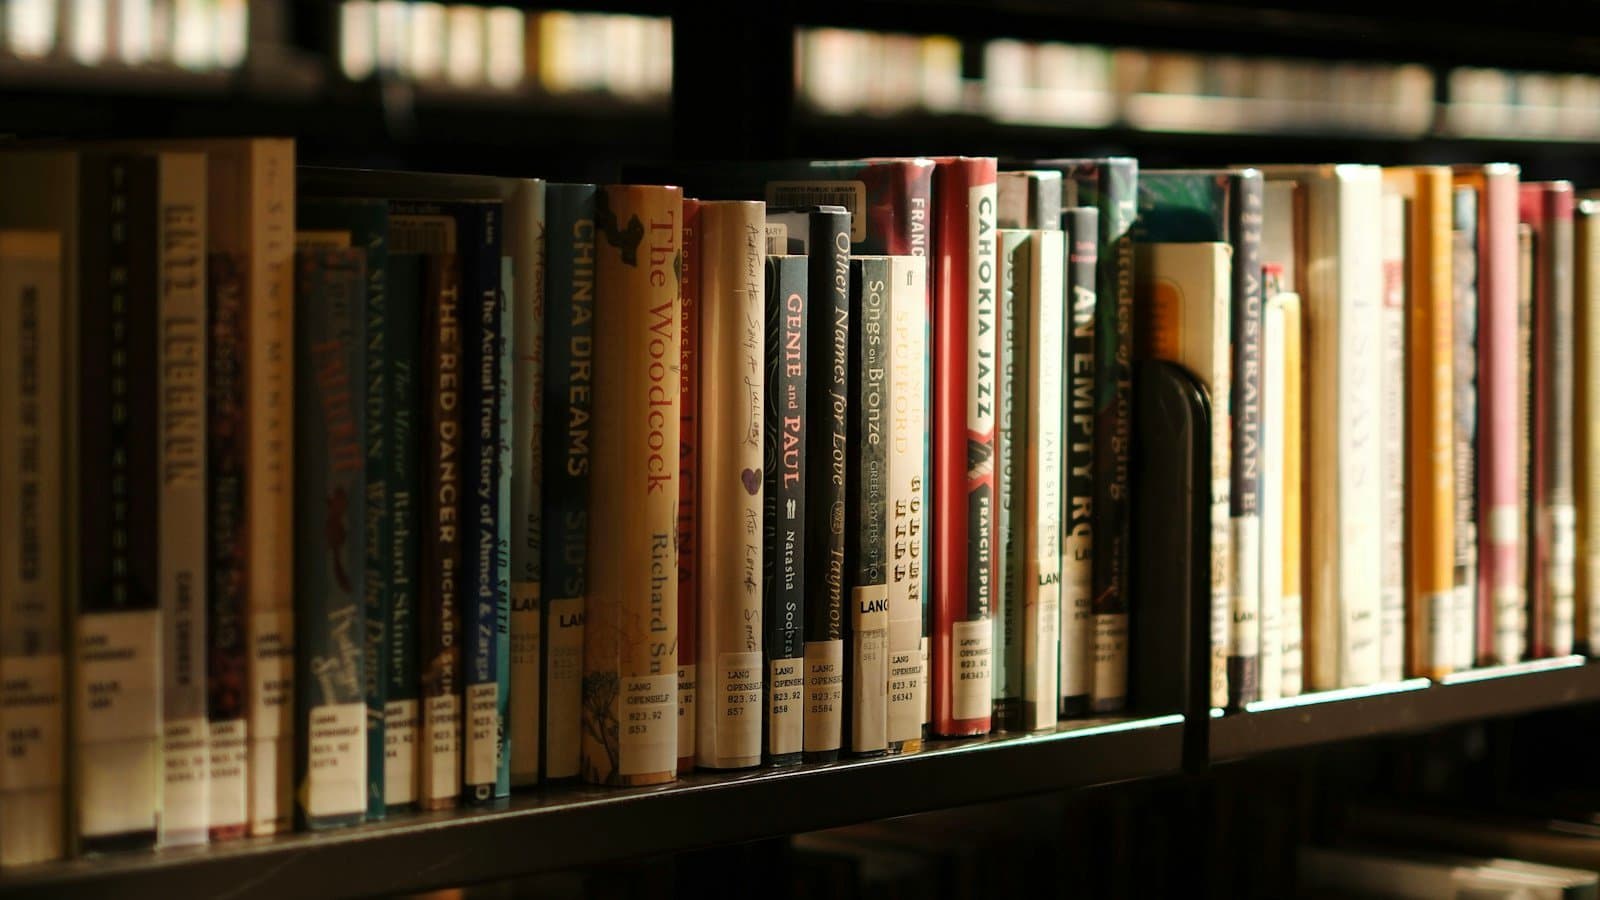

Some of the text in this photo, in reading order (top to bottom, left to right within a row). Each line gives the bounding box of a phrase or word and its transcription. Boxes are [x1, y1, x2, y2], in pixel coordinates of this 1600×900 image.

[910, 197, 925, 257] FRANC
[834, 231, 850, 299] Other
[681, 227, 692, 394] Fiona Snyckers
[976, 196, 992, 419] CAHOKIA JAZZ
[1072, 284, 1097, 339] AN
[566, 218, 594, 476] CHINA DREAMS
[647, 210, 675, 496] The Woodcock
[832, 306, 848, 384] Names
[866, 279, 884, 445] Songs on Bronze
[1243, 274, 1258, 479] AUSTRALIAN
[438, 285, 458, 545] THE RED DANCER
[784, 292, 803, 489] GENIE and PAUL
[827, 389, 848, 425] for
[1071, 353, 1096, 481] EMPTY
[476, 287, 496, 681] The Actual True Story of Ahmed & Zarga
[831, 432, 845, 486] Love
[391, 490, 411, 585] Richard
[869, 460, 880, 584] GREEK MYTHS RETO
[908, 476, 921, 601] GOLDEN
[1046, 479, 1055, 559] STEVENS
[1071, 495, 1093, 540] RO
[495, 537, 508, 636] SID SMITH
[649, 533, 669, 634] Richard
[785, 529, 796, 591] Natasha
[978, 496, 989, 621] FRANCIS SPUFF
[1039, 574, 1060, 586] LAN
[439, 556, 456, 697] RICHARD SKIN
[560, 612, 586, 628] LAN
[1004, 564, 1014, 646] STEVENSON
[391, 590, 411, 687] Skinner
[774, 665, 795, 676] LANG
[811, 663, 835, 674] LANG
[892, 654, 910, 665] LANG
[626, 682, 653, 693] LANG
[627, 693, 672, 705] OPENSHELF
[727, 670, 751, 681] LANG
[727, 693, 758, 705] 823.92
[773, 690, 801, 703] 823.92
[774, 676, 804, 689] OPENSH
[811, 690, 841, 702] 823.92
[892, 680, 918, 691] 823.92
[892, 692, 914, 703] S6343
[628, 711, 663, 722] 823.92
[727, 706, 745, 717] S57
